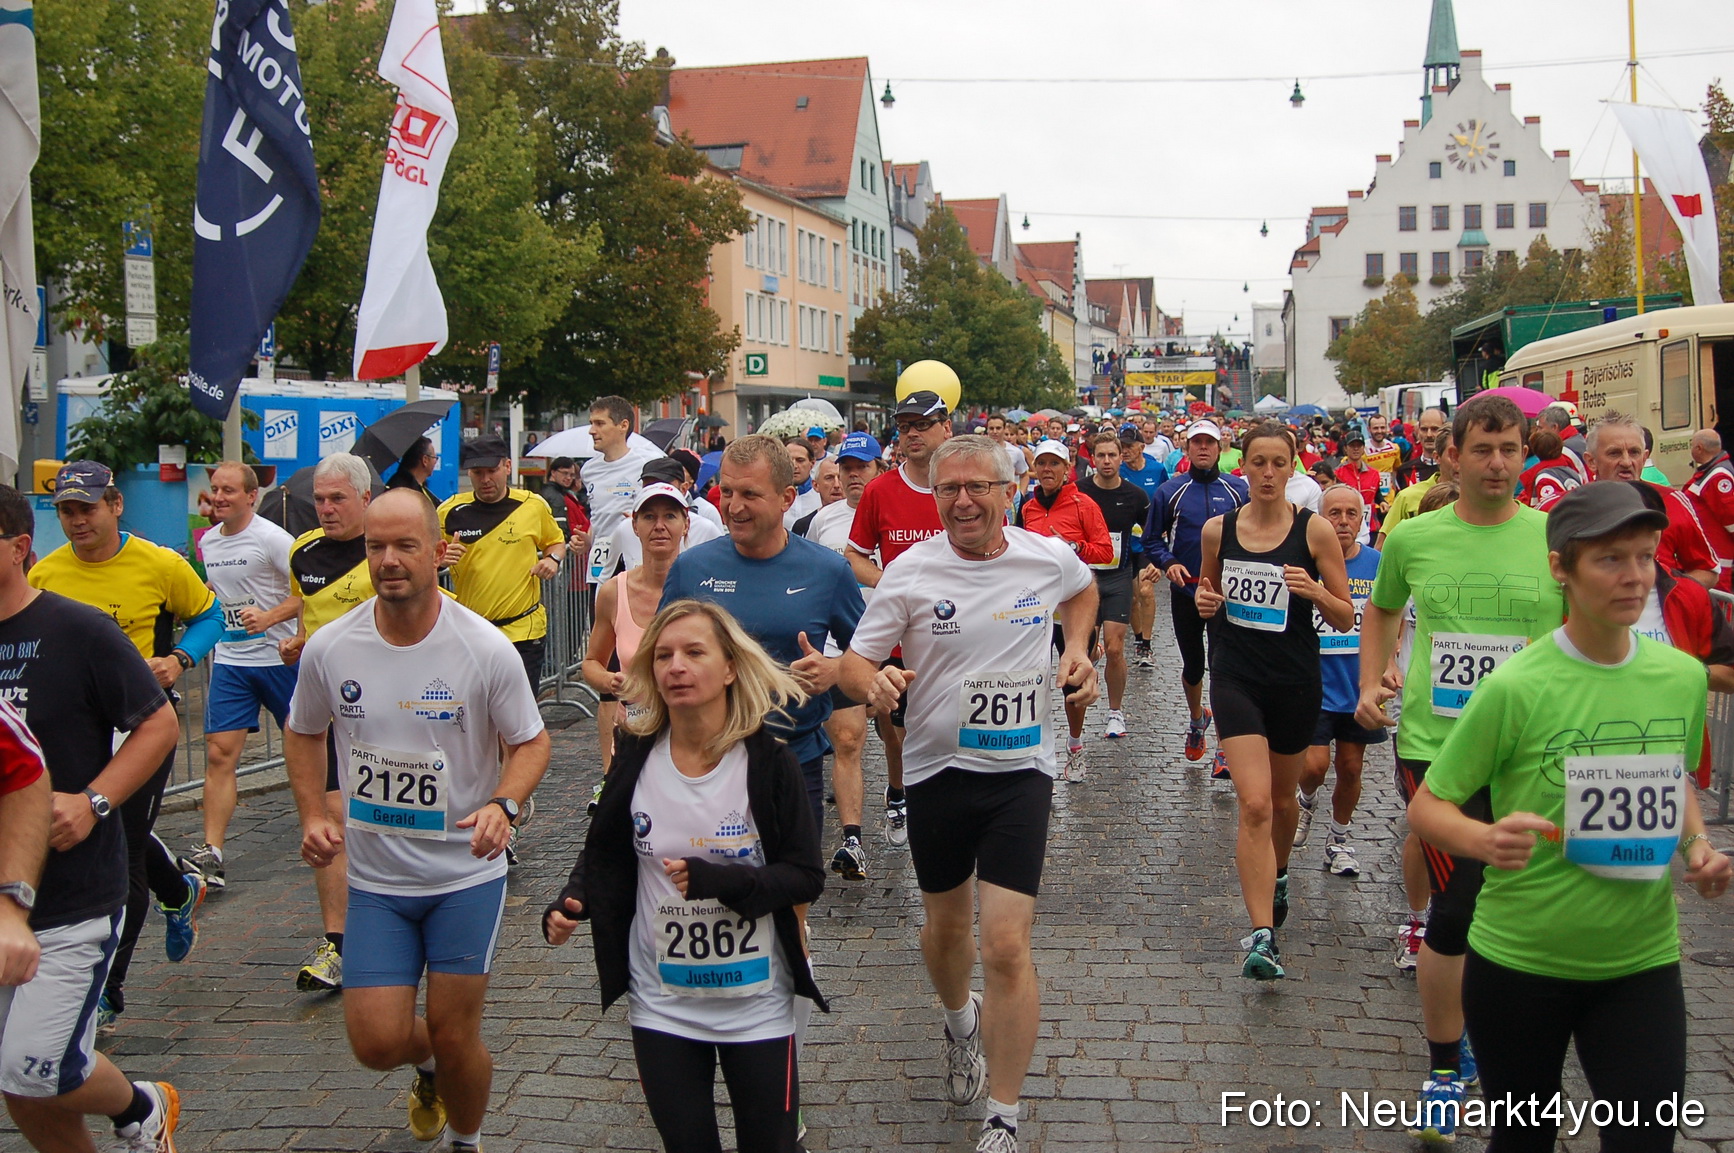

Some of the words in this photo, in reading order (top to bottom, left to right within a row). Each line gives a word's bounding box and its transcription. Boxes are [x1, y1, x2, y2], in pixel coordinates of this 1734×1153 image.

[750, 356, 764, 371] D
[1154, 374, 1184, 383] START
[1583, 360, 1634, 388] Bayerisches
[1583, 390, 1607, 409] Rotes
[459, 529, 482, 537] Robert
[1224, 565, 1245, 575] PARTL
[1245, 568, 1278, 578] Neumarkt
[1227, 576, 1283, 605] 2837
[1241, 606, 1263, 620] Petra
[932, 622, 960, 630] PARTL
[1330, 638, 1349, 646] Gerd
[1433, 640, 1462, 650] PARTL
[1464, 643, 1509, 653] Neumarkt
[963, 679, 995, 689] PARTL
[997, 678, 1035, 689] Neumarkt
[339, 704, 365, 714] PARTL
[969, 690, 1037, 726] 2611
[978, 733, 1031, 749] Wolfgang
[351, 748, 379, 764] PARTL
[381, 756, 429, 770] Neumarkt
[1568, 769, 1612, 780] PARTL
[1615, 768, 1669, 780] Neumarkt
[357, 764, 438, 806] 2126
[373, 808, 415, 826] Gerald
[1579, 785, 1677, 832] 2385
[1610, 844, 1655, 862] Anita
[665, 917, 760, 960] 2862
[686, 970, 743, 988] Justyna
[23, 1055, 52, 1079] 78
